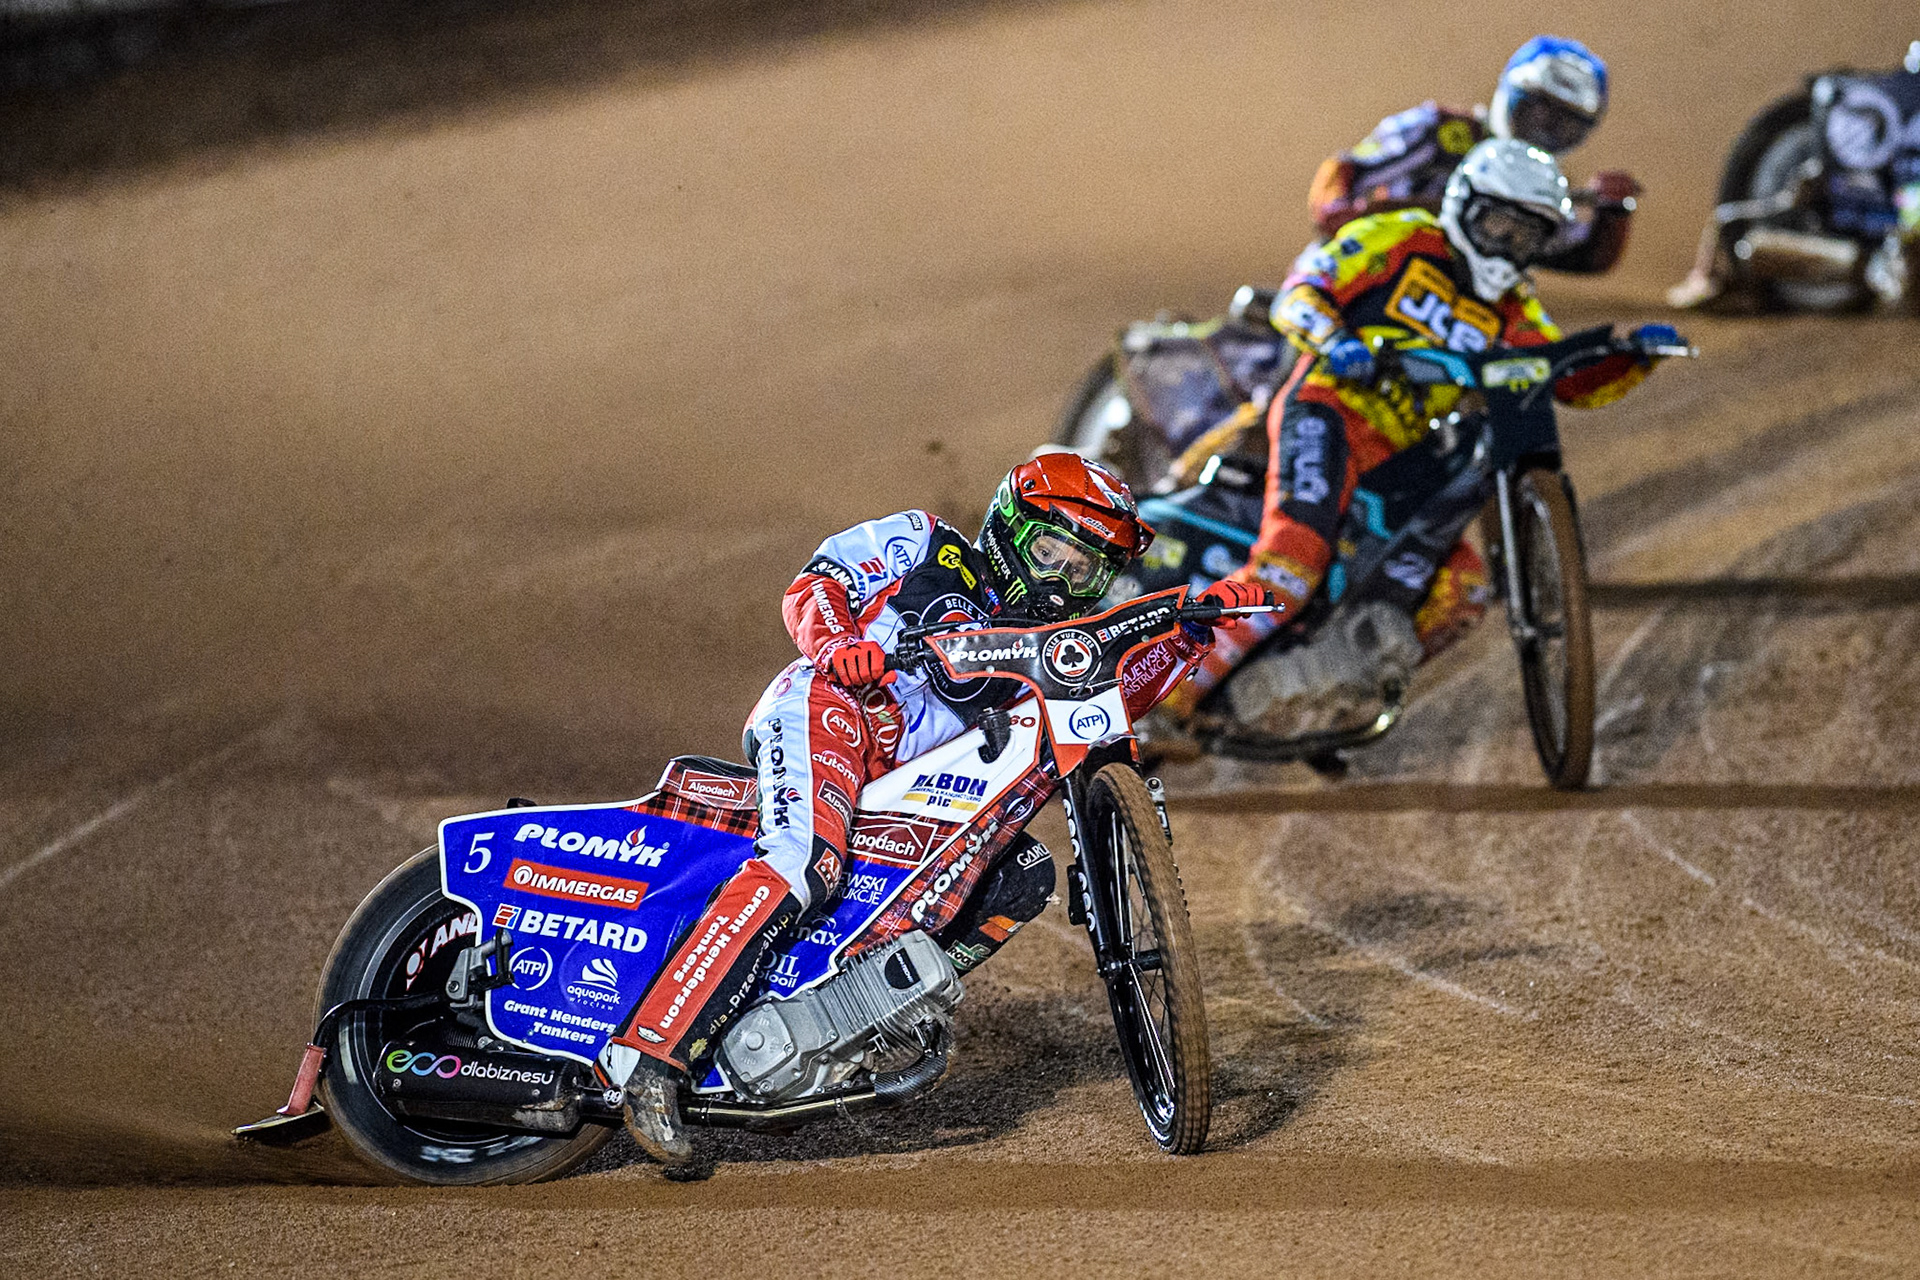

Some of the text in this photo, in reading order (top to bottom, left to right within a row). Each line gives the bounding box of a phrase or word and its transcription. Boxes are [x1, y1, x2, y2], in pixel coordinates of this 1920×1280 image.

[892, 543, 913, 574] ATPI
[987, 528, 1012, 580] MONSTER
[945, 598, 974, 616] BELLE
[1046, 632, 1095, 657] BELLE VUE ACES
[829, 715, 857, 742] ATPI
[1076, 714, 1105, 731] ATPI
[688, 782, 736, 798] Alpodach
[926, 796, 952, 808] plc
[463, 832, 496, 874] 5
[513, 823, 669, 868] PŁOMYK
[910, 821, 999, 923] PŁOMYK
[530, 873, 640, 904] IMMERGAS
[519, 910, 648, 954] BETARD
[659, 885, 771, 1030] Grant Henderson
[672, 914, 730, 983] Tankers
[513, 958, 546, 977] ATPI
[566, 985, 621, 1005] aquapark
[504, 999, 548, 1020] Grant
[533, 1021, 596, 1045] Tankers
[460, 1061, 555, 1085] dlabiznesu
